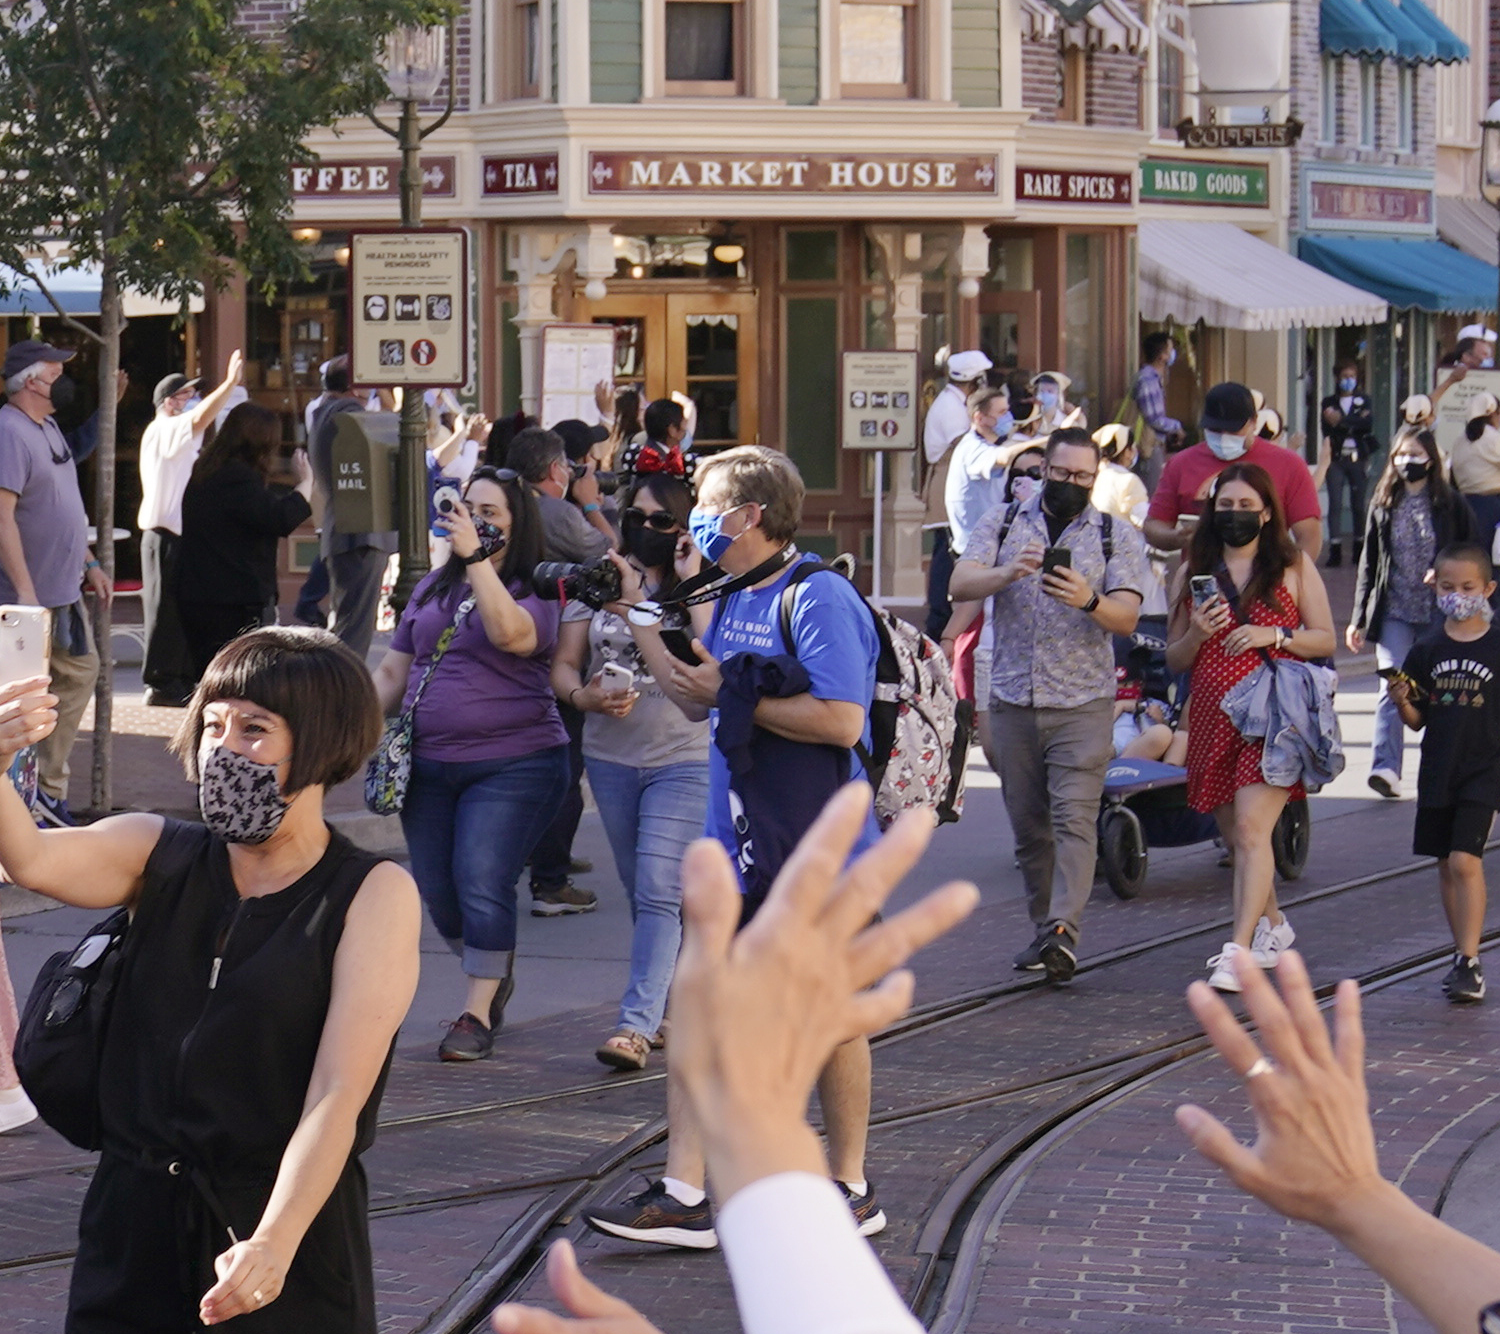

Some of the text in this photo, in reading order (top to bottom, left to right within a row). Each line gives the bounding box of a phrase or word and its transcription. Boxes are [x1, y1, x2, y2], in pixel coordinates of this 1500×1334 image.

[292, 166, 390, 191] FFEE
[503, 163, 538, 188] TEA
[630, 161, 958, 187] MARKET HOUSE
[1023, 172, 1116, 200] RARE SPICES
[1154, 168, 1249, 195] BAKED GOODS
[400, 252, 417, 260] AND
[340, 462, 364, 474] U.S.
[338, 478, 367, 490] MAIL
